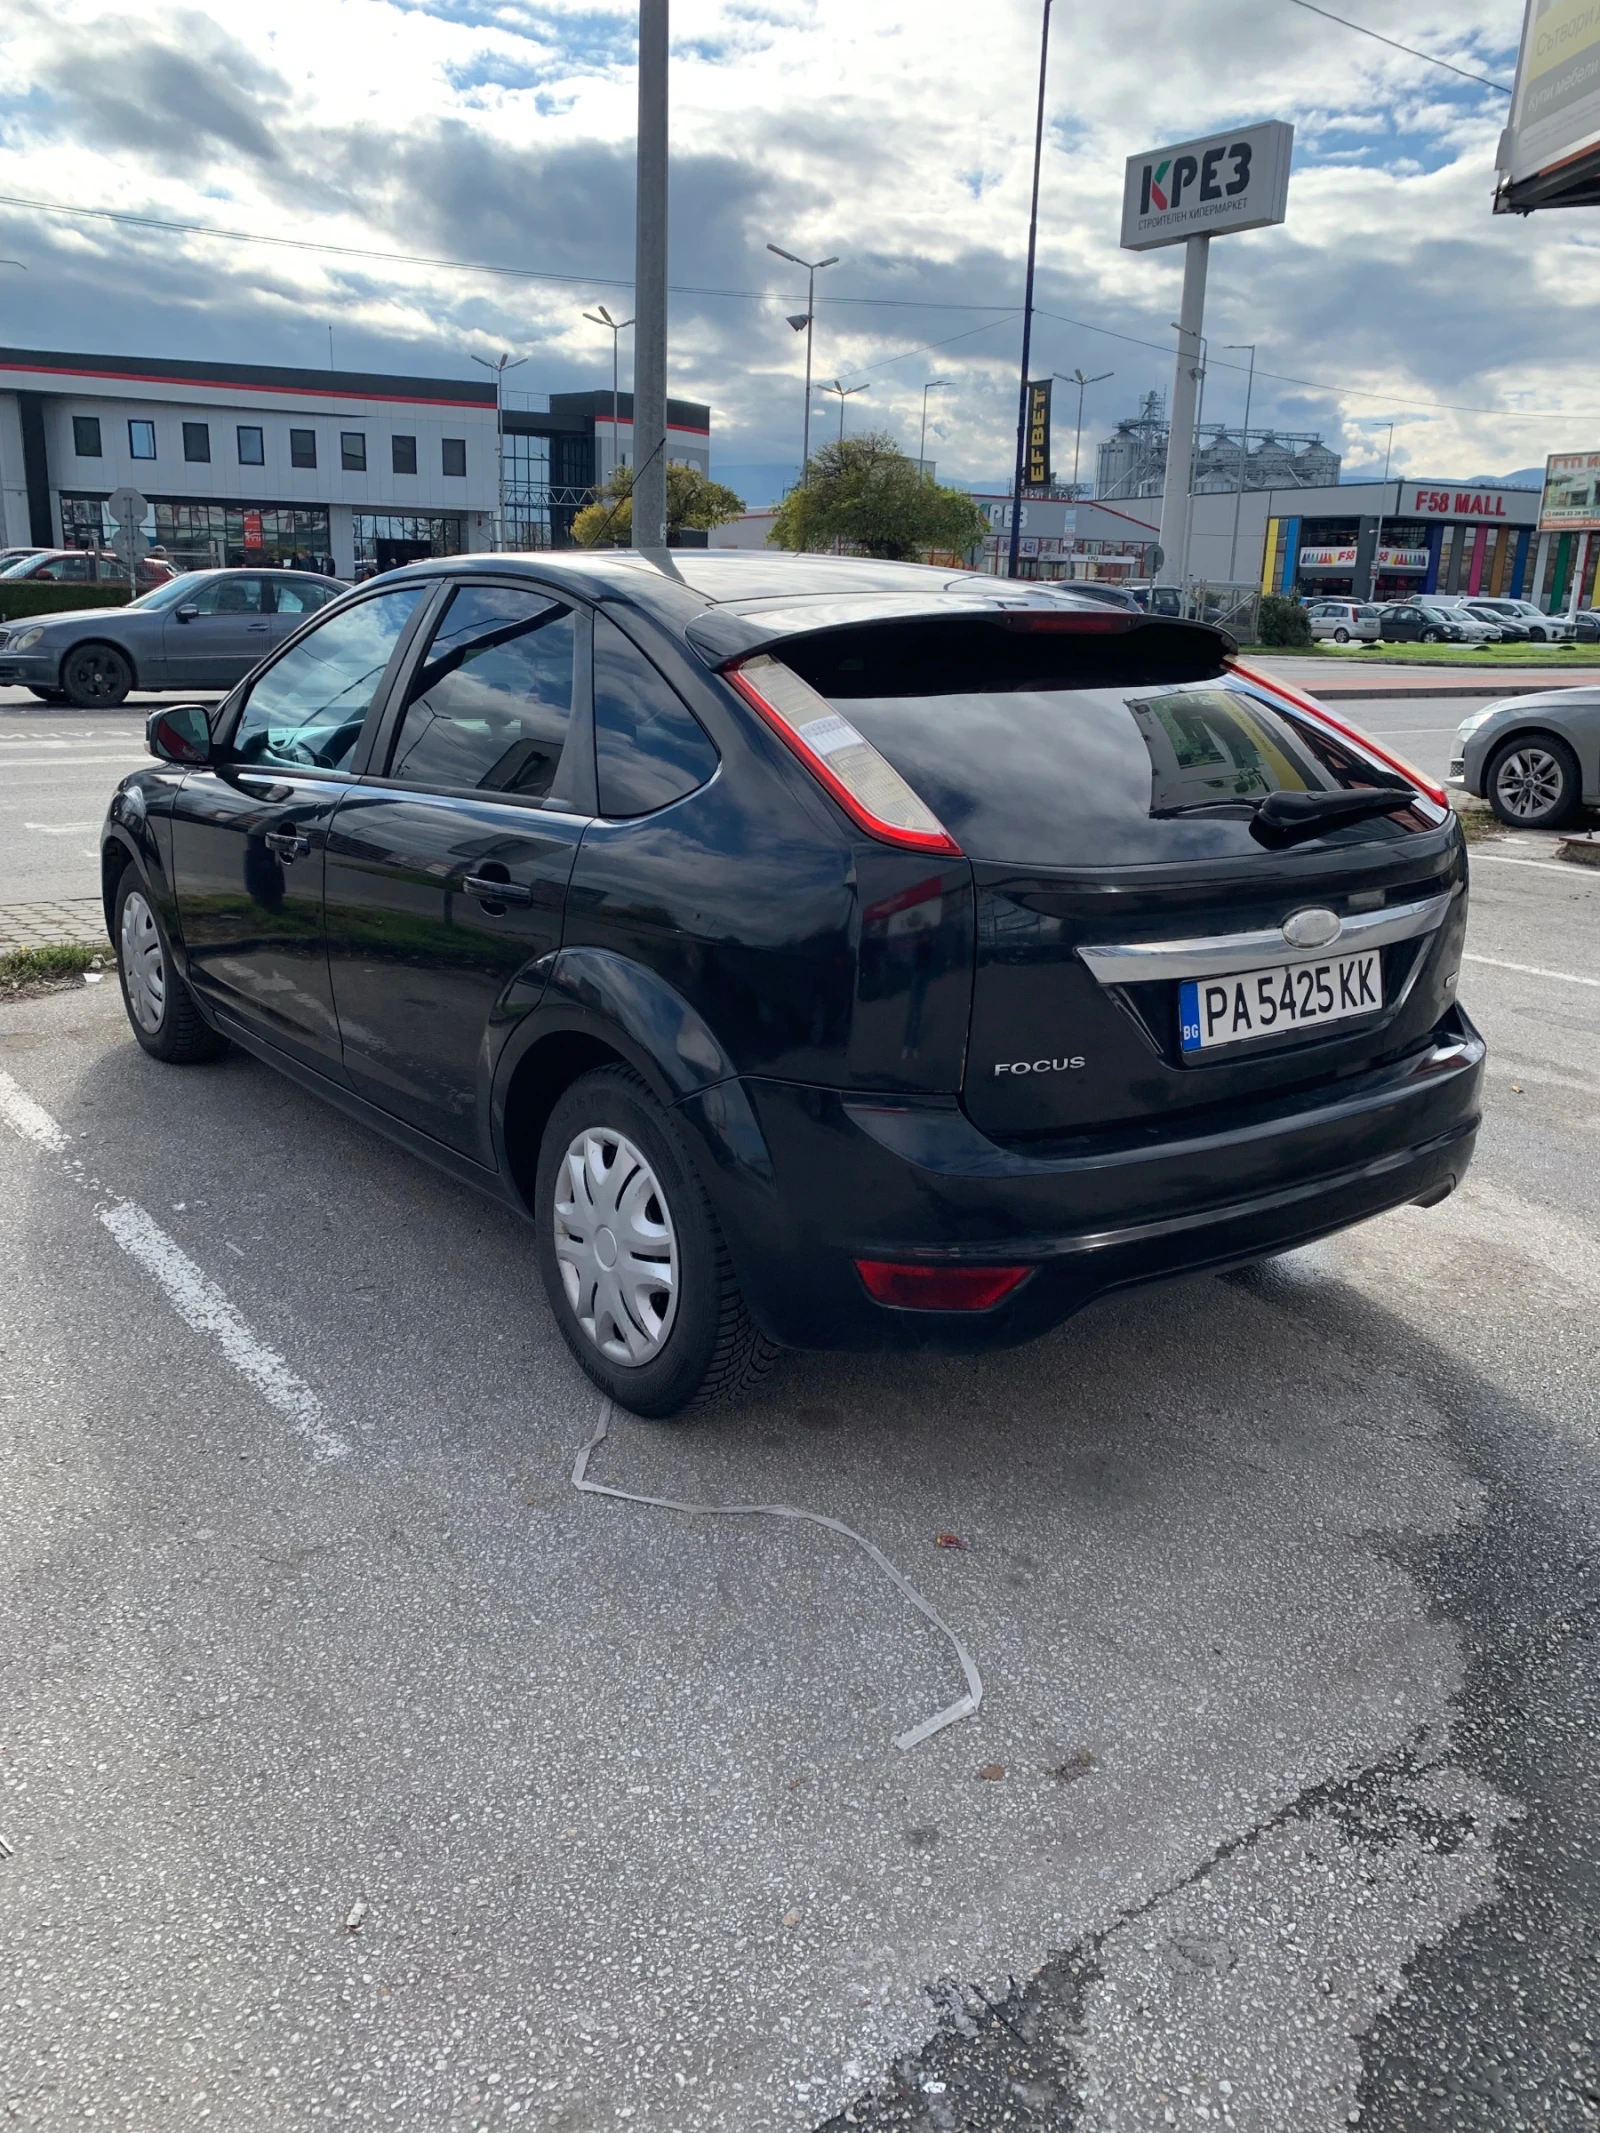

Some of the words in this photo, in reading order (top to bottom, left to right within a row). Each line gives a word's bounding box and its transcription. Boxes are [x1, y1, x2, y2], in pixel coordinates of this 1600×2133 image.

[1536, 5, 1594, 57] Сътвори
[1528, 83, 1554, 112] Купи
[1140, 141, 1253, 215] КРЕЗ
[1138, 210, 1187, 231] СТРОИТЕЛЕН
[1189, 197, 1248, 220] ХИПЕРМАРКЕТ
[1030, 388, 1046, 481] EFBET
[1587, 455, 1600, 468] И
[1415, 491, 1450, 512] F58
[1454, 493, 1507, 516] MALL
[1337, 550, 1356, 561] F58
[1378, 551, 1389, 561] 58
[1206, 983, 1252, 1037] PA
[1257, 966, 1334, 1025] 5425
[1339, 958, 1376, 1009] KK
[1183, 1025, 1199, 1040] BG
[994, 1056, 1086, 1076] FOCUS
